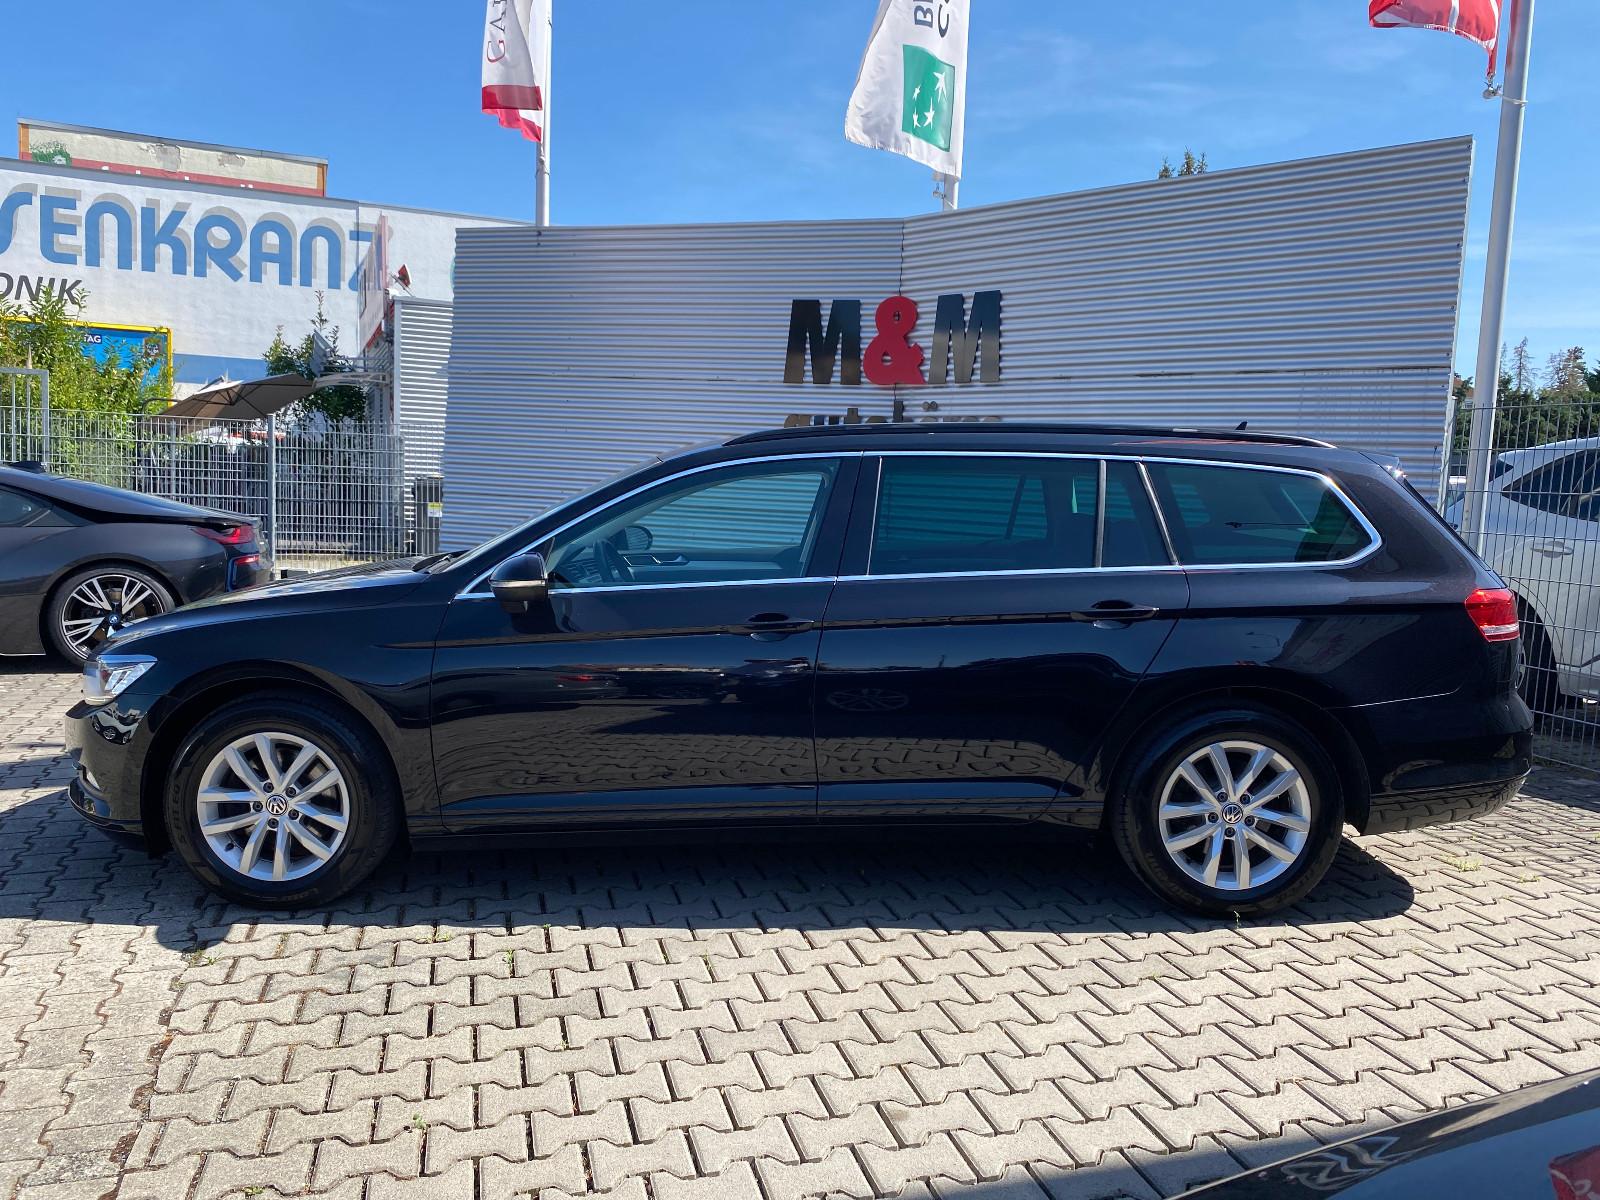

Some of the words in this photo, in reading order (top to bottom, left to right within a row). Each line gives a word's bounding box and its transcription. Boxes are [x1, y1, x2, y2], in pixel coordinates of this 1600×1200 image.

[914, 0, 933, 28] B
[938, 0, 949, 38] C
[783, 289, 1001, 385] M&M
